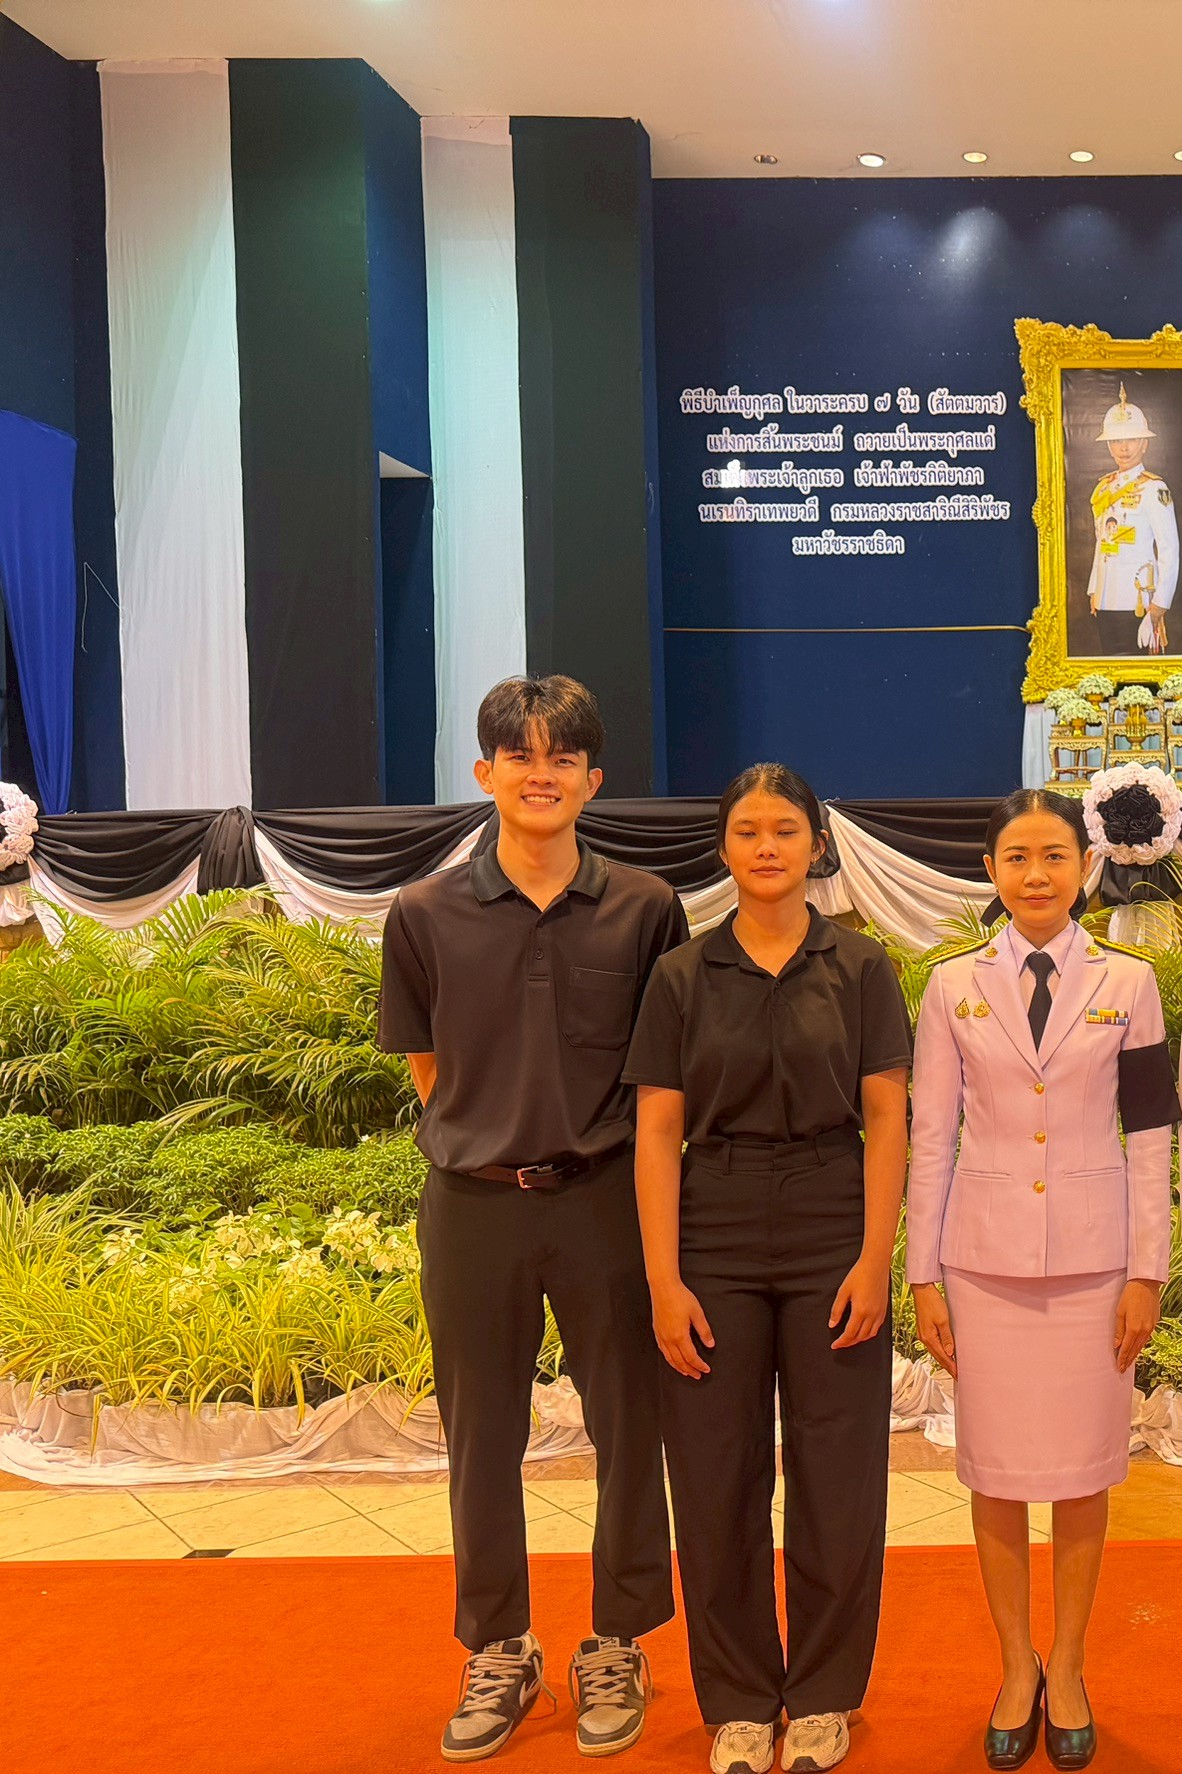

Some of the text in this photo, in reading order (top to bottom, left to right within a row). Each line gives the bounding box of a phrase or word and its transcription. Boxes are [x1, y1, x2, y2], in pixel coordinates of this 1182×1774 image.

[680, 385, 1007, 421] พิธีบำเพ็ญกุศล ในวาระครบ ๗ วัน (สัตตมวาร)
[707, 422, 996, 458] แห่งการสิ้นพระชนม์ ถวายเป็นพระกุศลแด่
[702, 459, 985, 494] สมพระเจ้าลูกเธอ เจ้าฟ้าพัชรกิติยาภา
[698, 494, 1011, 522] นเรนทิราเทพยวดี กรมหลวงราชสาริณีสิริพัชร
[792, 529, 905, 556] มหาวัชรราชธิดา
